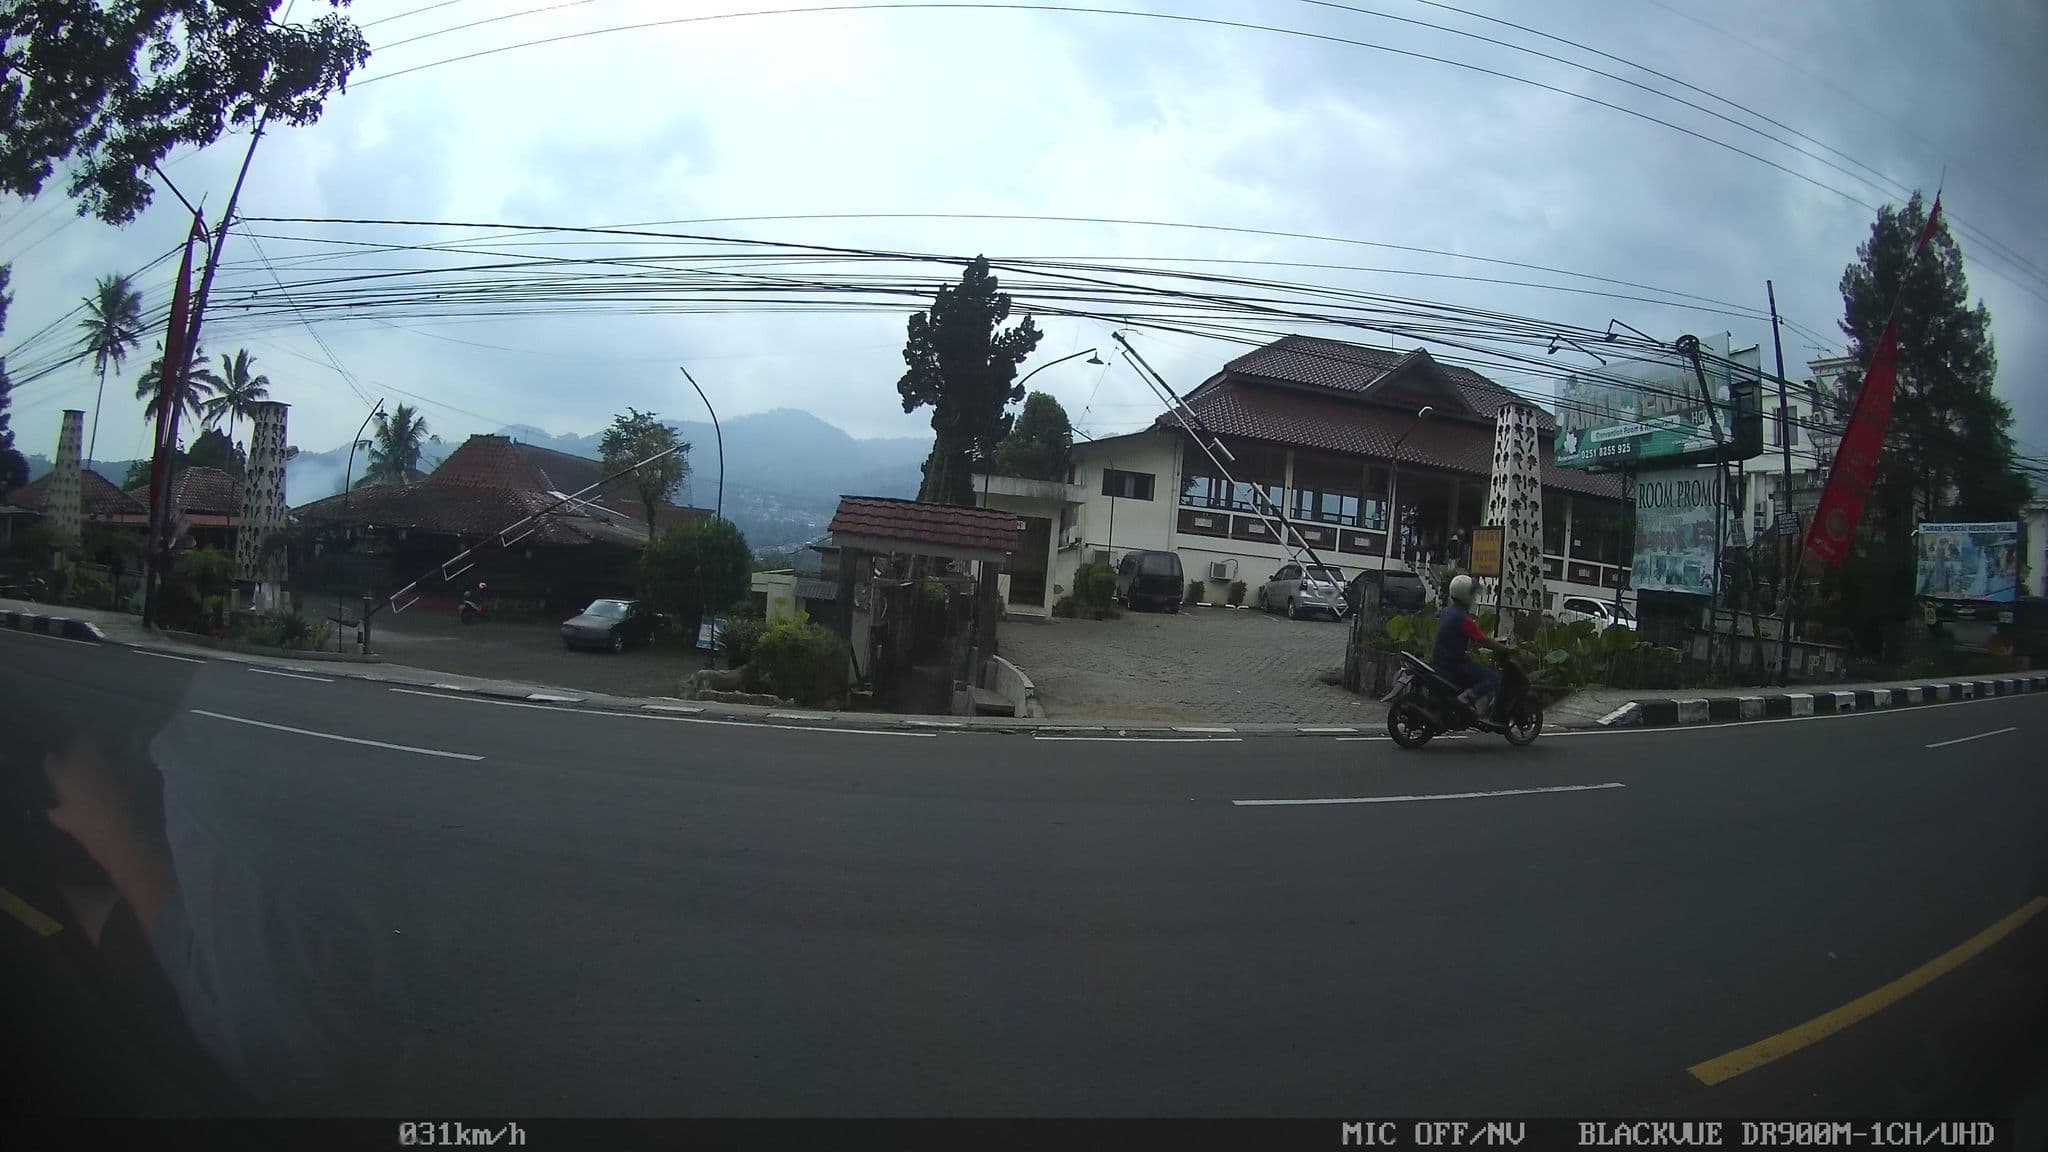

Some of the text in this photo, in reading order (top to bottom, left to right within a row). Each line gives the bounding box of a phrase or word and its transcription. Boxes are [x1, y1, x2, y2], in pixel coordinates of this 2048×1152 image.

[1581, 449, 1597, 459] 0251
[1599, 445, 1616, 457] 8255
[1617, 443, 1631, 454] 925
[1638, 481, 1673, 509] ROOM
